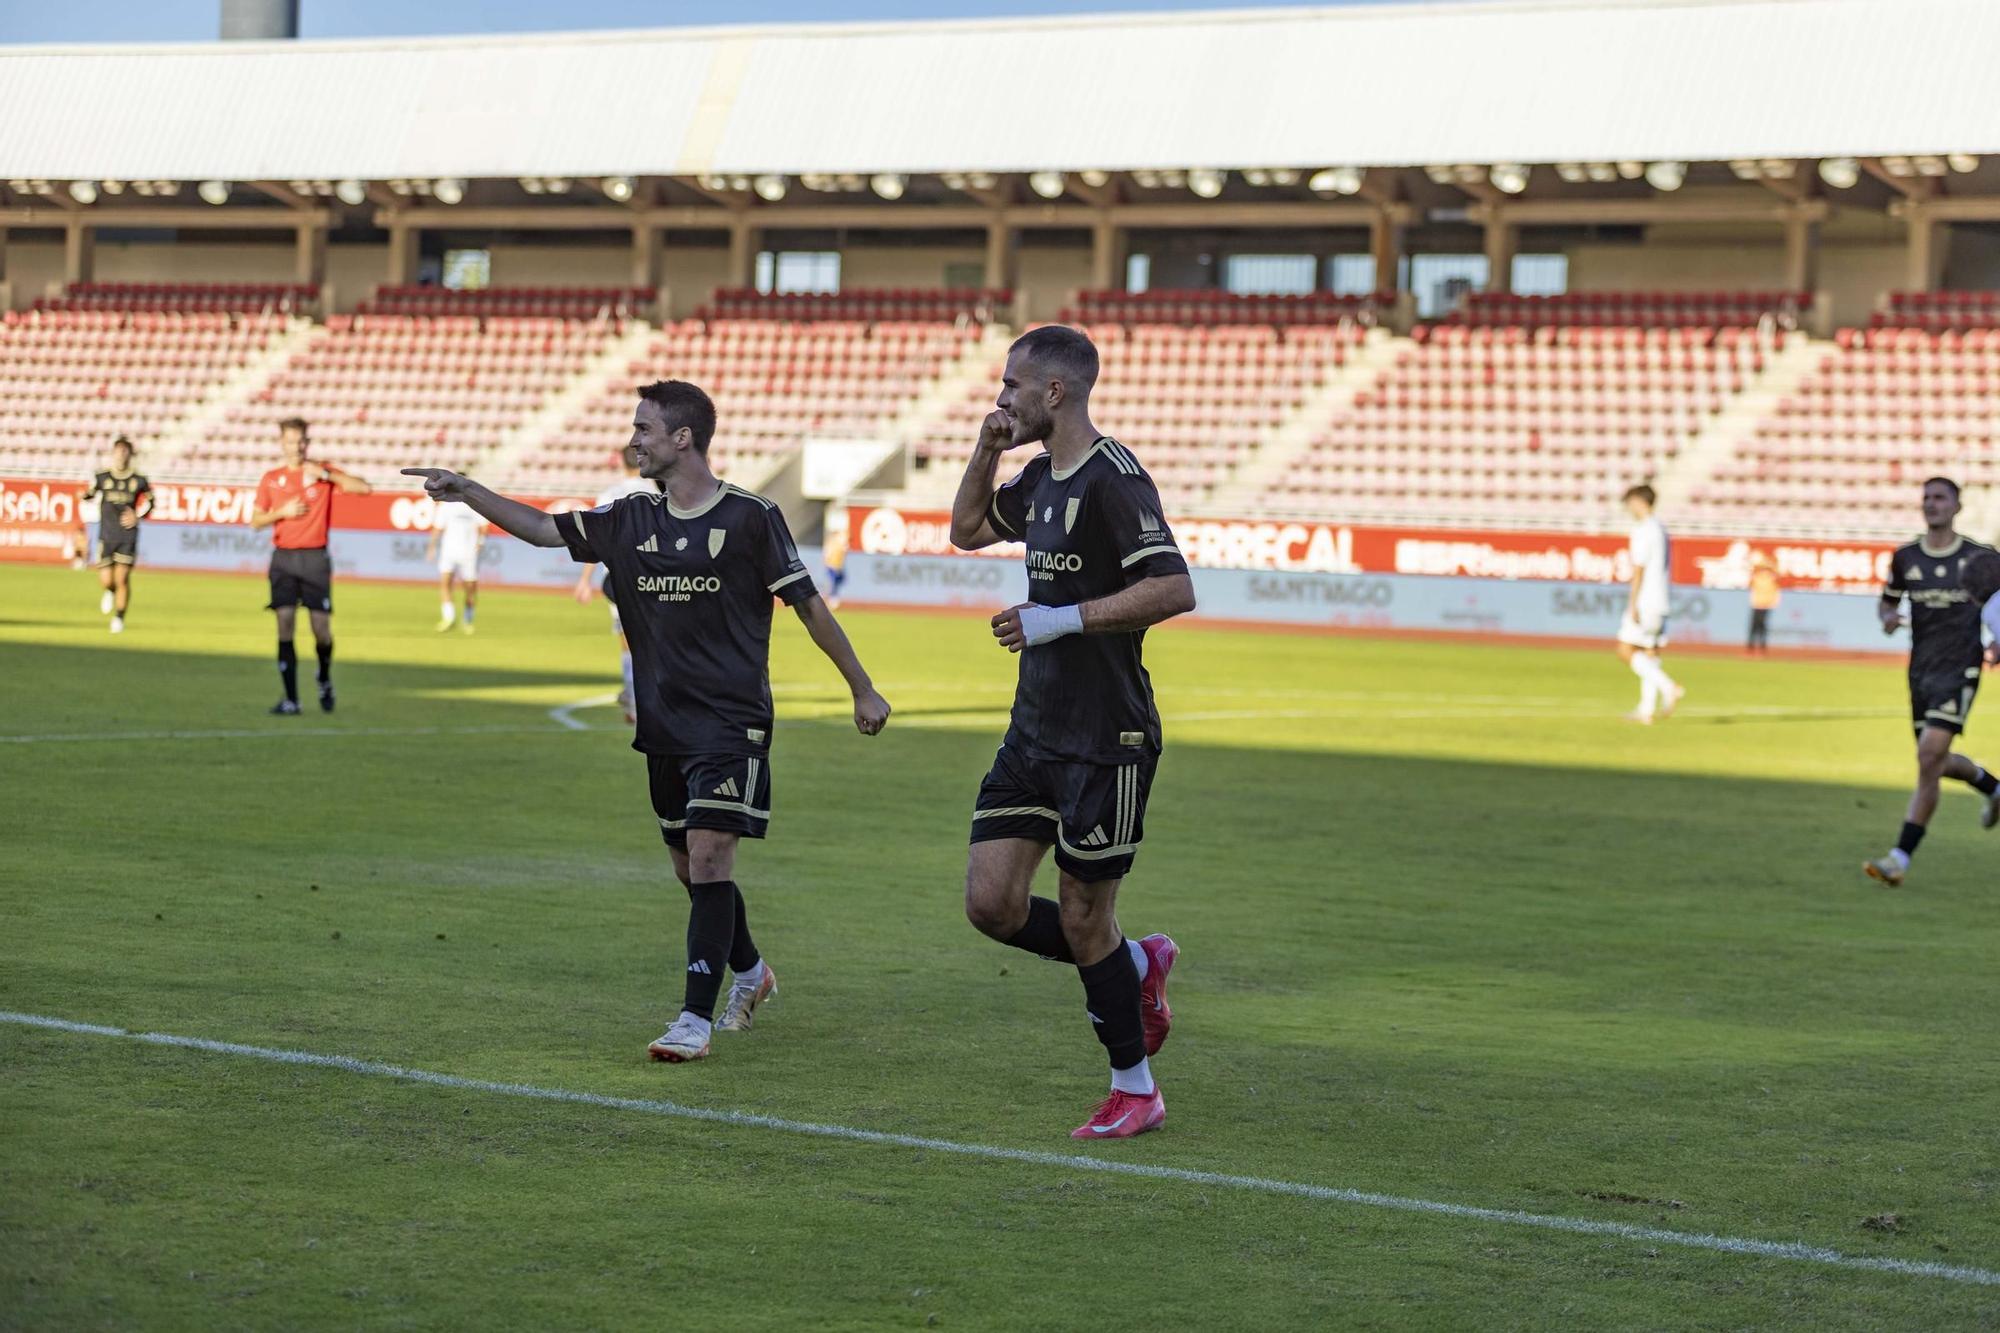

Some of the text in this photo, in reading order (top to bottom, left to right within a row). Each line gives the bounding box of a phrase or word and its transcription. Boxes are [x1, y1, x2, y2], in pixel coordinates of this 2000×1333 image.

[180, 529, 272, 555] SANTIAG
[1170, 521, 1363, 574] ERRECAL
[1026, 550, 1083, 572] ANTIAGO
[637, 576, 721, 593] SANTIAGO
[1031, 570, 1038, 580] en
[658, 593, 669, 602] en
[1249, 575, 1394, 607] SANTIAGO
[1552, 586, 1712, 622] SANTGO
